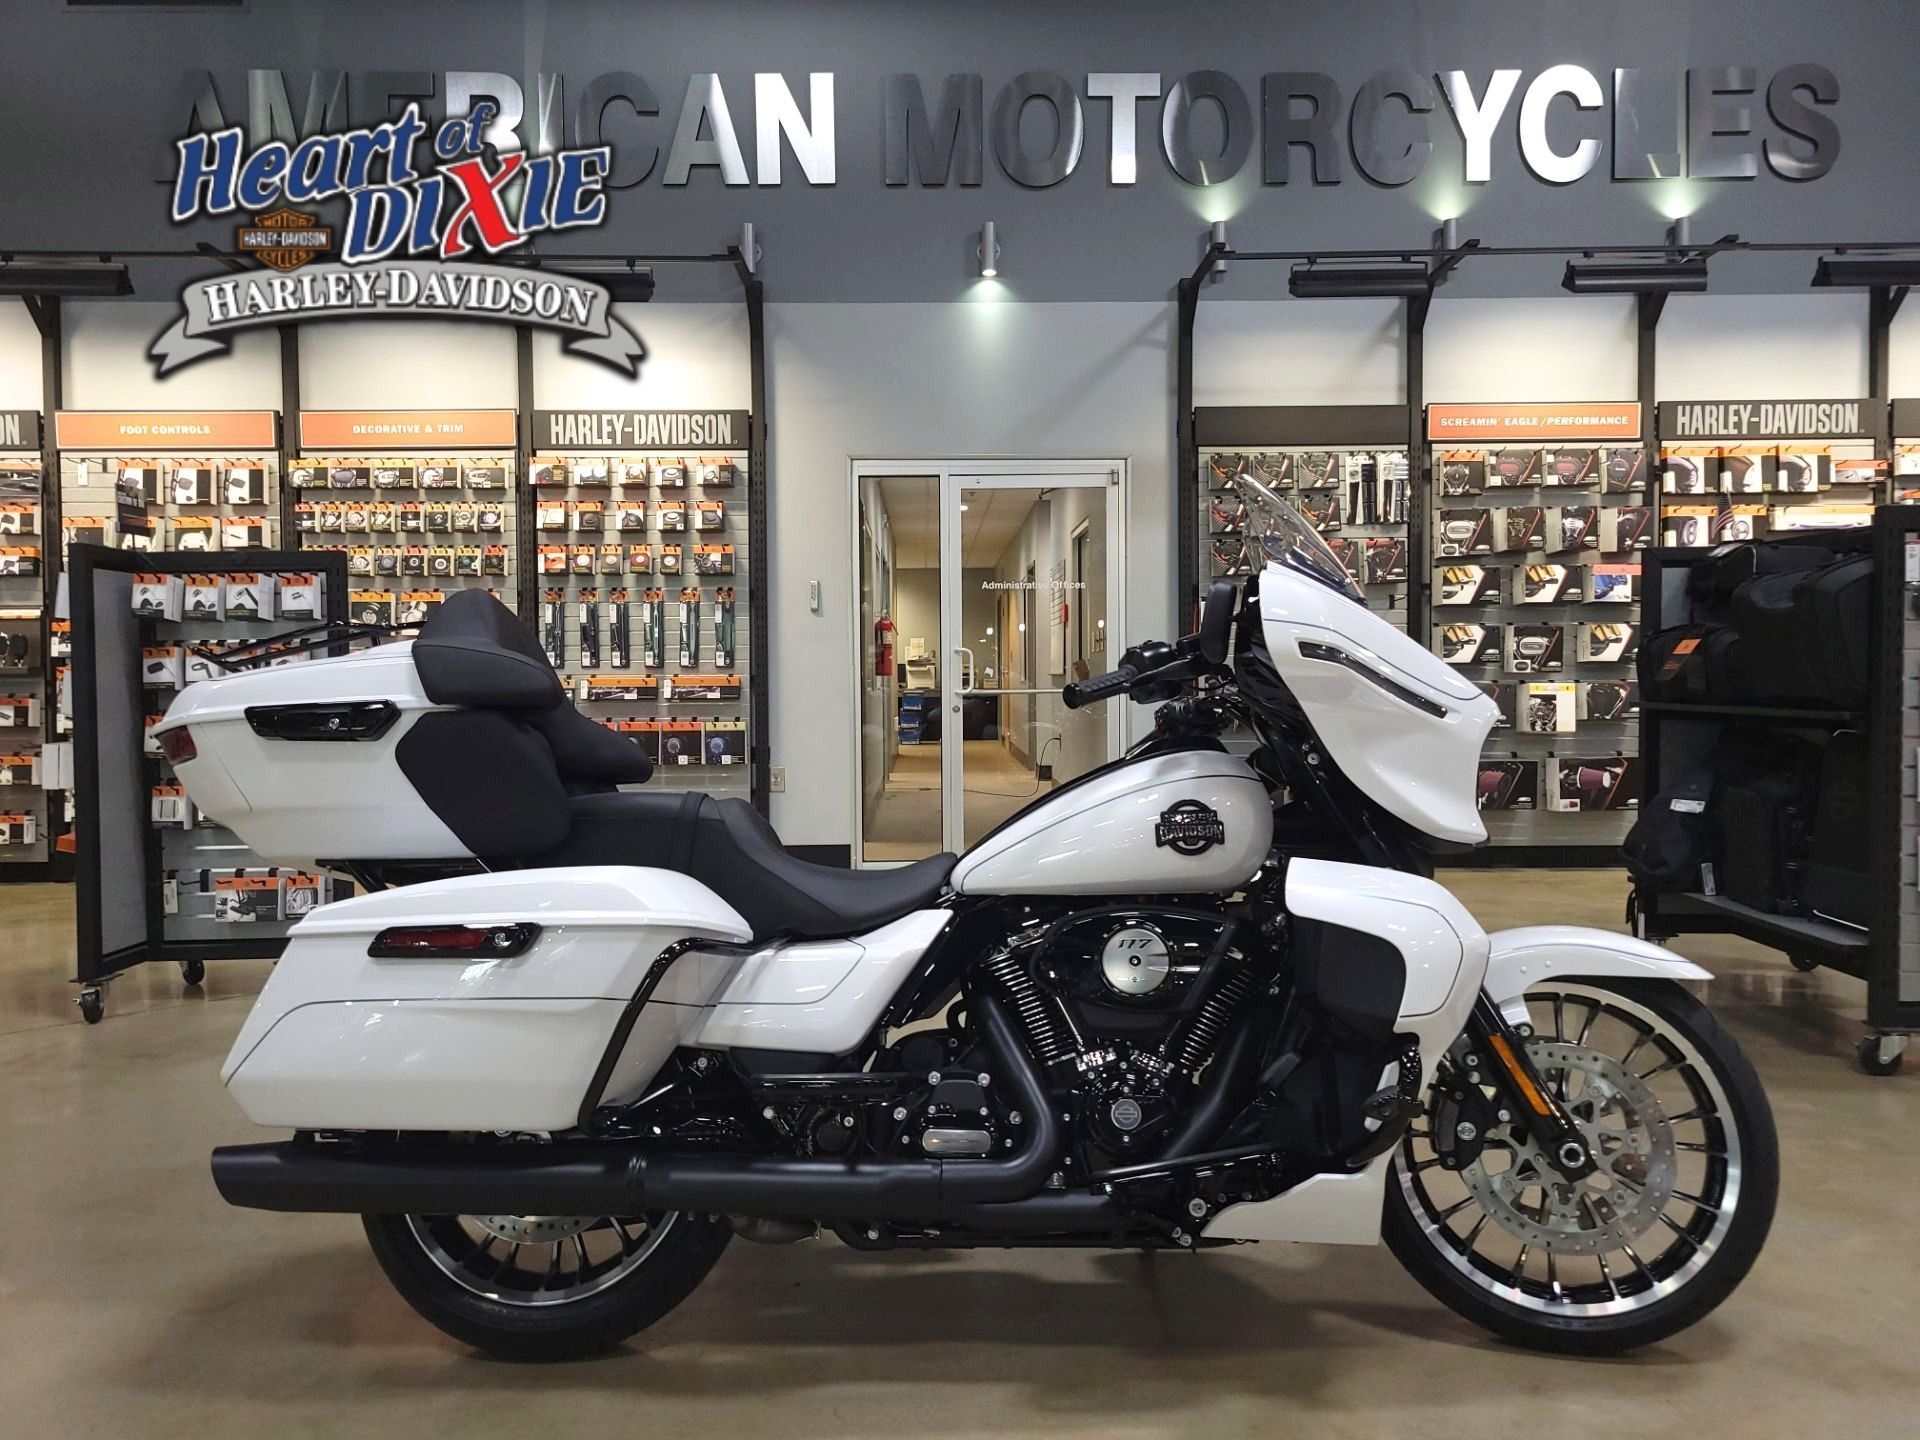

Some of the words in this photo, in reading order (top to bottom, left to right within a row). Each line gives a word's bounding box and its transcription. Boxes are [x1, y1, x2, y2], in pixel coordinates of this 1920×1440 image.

[882, 63, 1842, 189] MOTORCYCLES
[1440, 417, 1501, 427] SCREAMIN'
[1676, 403, 1860, 436] HARLEY-DAVIDSON
[119, 425, 148, 435] FOOT
[151, 425, 212, 435] CONTROLS
[352, 424, 421, 434] DECORATIVE
[424, 425, 433, 433] &
[436, 424, 465, 433] TRIM
[550, 413, 732, 445] HARLEY-DAVIDSON
[981, 581, 1051, 590] Administrative
[1052, 581, 1087, 590] Offices
[1117, 937, 1155, 949] 117
